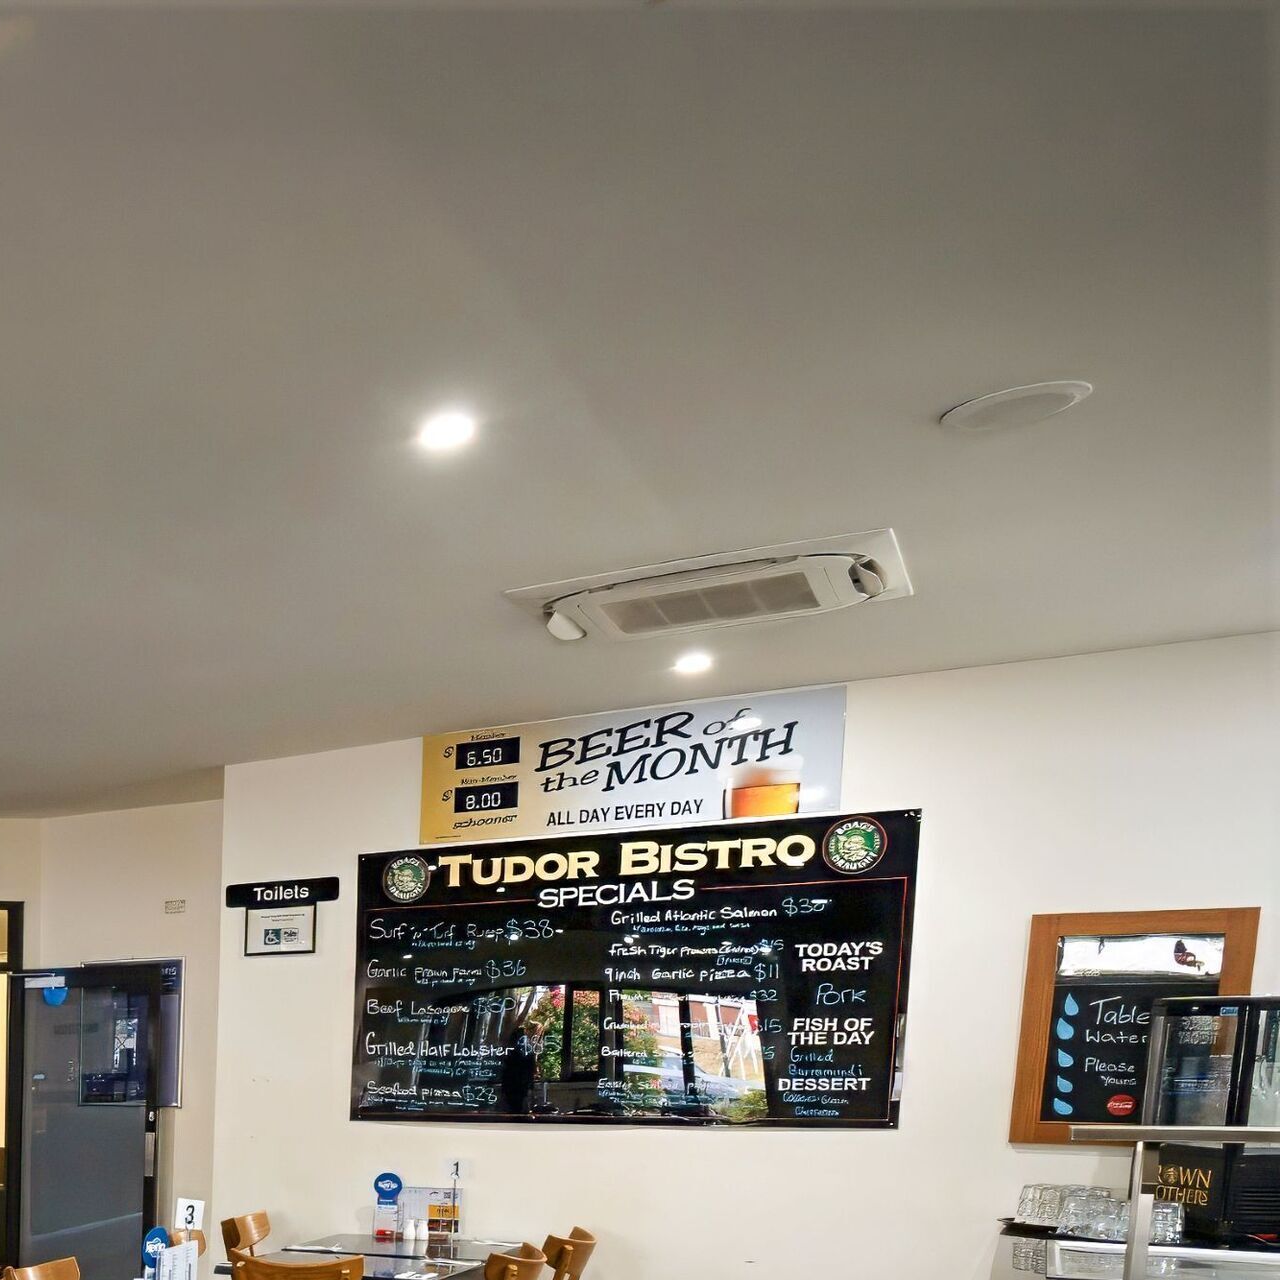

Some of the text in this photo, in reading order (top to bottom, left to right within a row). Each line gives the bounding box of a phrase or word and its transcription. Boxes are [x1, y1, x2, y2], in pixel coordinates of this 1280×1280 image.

[534, 707, 752, 772] BEER of
[466, 748, 502, 766] 6.50
[540, 720, 799, 793] the MONTH
[466, 792, 501, 809] 8.00
[546, 799, 704, 827] ALL DAY EVERY DAY
[438, 834, 816, 888] TUDOR BISTRO
[253, 885, 310, 901] Toilets
[537, 878, 696, 909] SPECIALS
[611, 911, 660, 925] Grilled
[720, 906, 778, 919] Salmon
[370, 918, 407, 940] Surf
[794, 941, 884, 957] TODAY'S
[801, 957, 874, 972] ROAST
[793, 1018, 873, 1032] FISH OF
[1086, 996, 1151, 1044] Table Water
[366, 1032, 416, 1056] Grilled
[453, 1043, 514, 1057] Lobster
[787, 1031, 875, 1046] THE DAY
[1084, 1057, 1135, 1073] Please
[778, 1078, 872, 1091] DESSERT
[185, 1205, 195, 1225] 3
